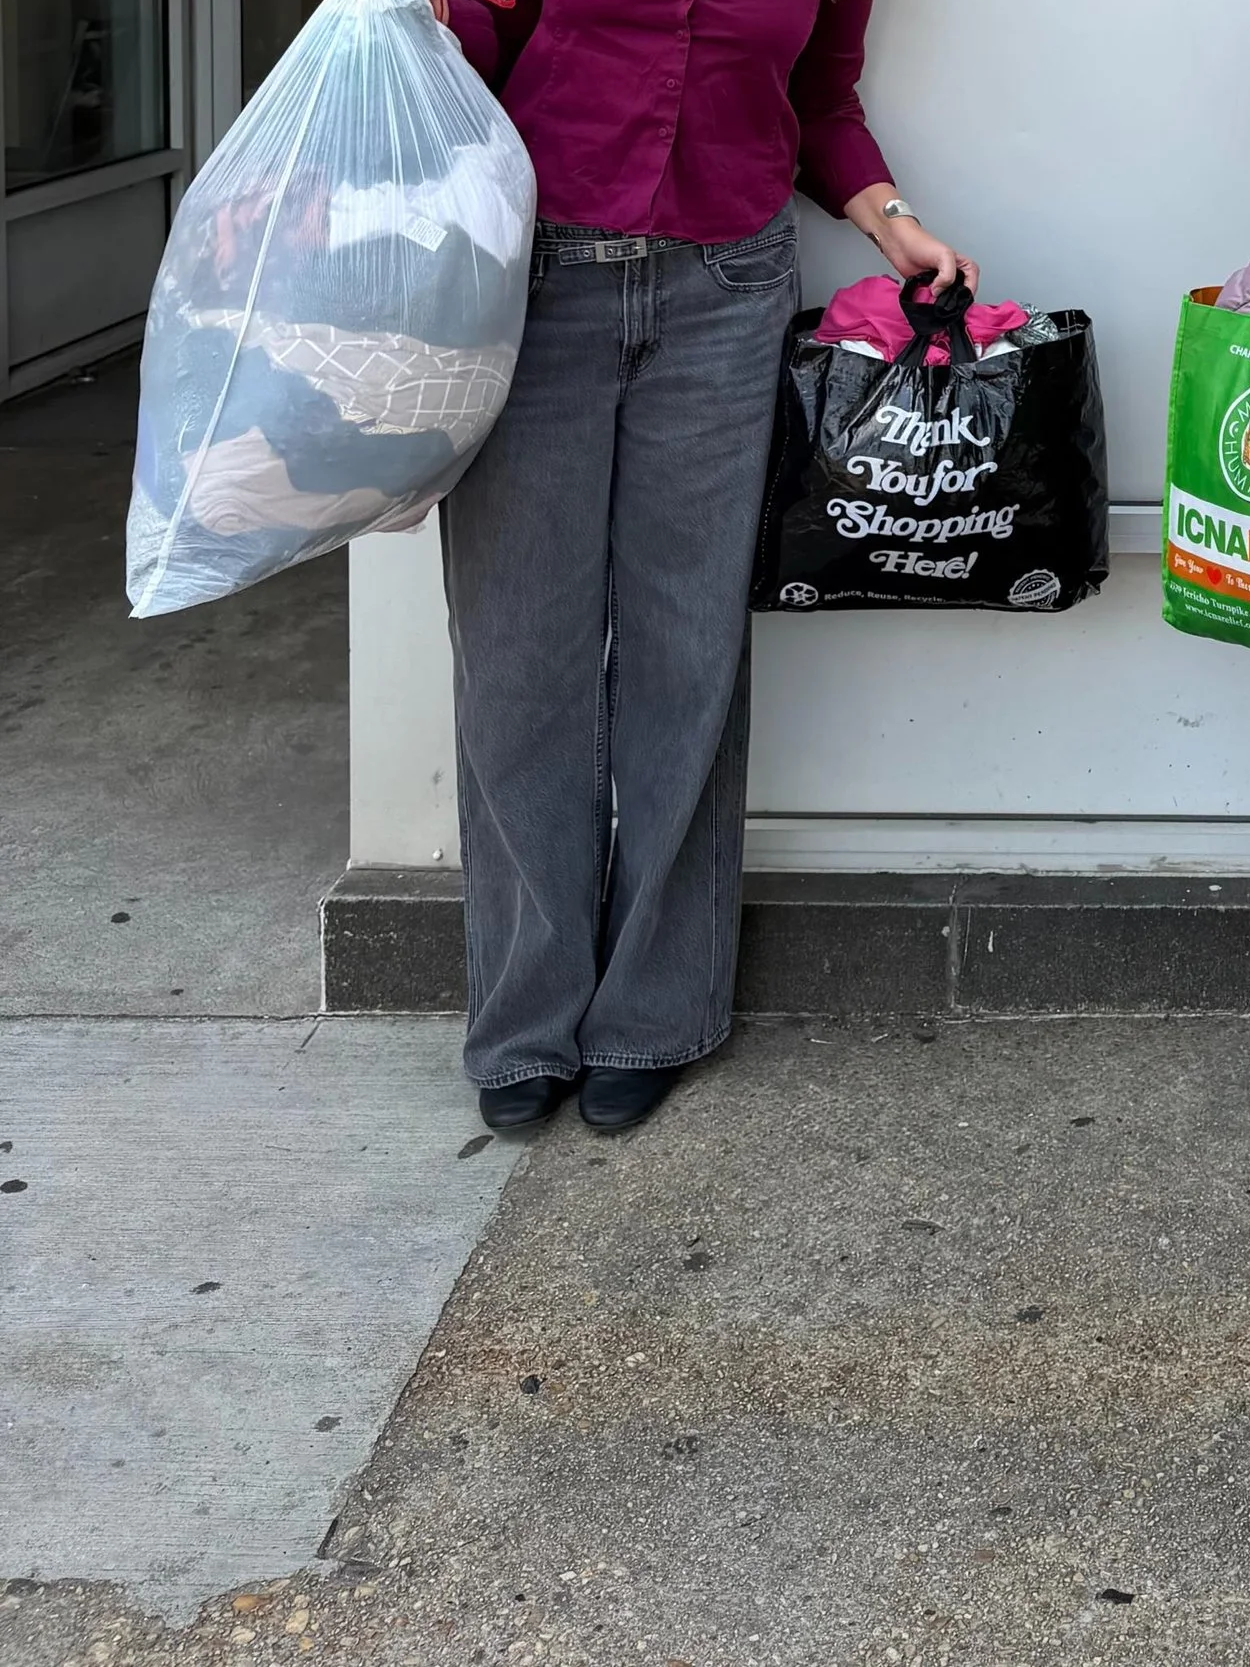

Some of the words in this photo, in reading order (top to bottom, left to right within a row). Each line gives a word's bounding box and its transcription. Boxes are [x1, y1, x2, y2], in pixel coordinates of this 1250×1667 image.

[847, 455, 930, 496] You
[913, 460, 998, 506] for
[826, 498, 1020, 544] Shopping
[869, 550, 979, 579] Here!
[824, 590, 865, 601] Reduce,
[867, 591, 902, 601] Reuse,
[1183, 587, 1210, 605] Jericho
